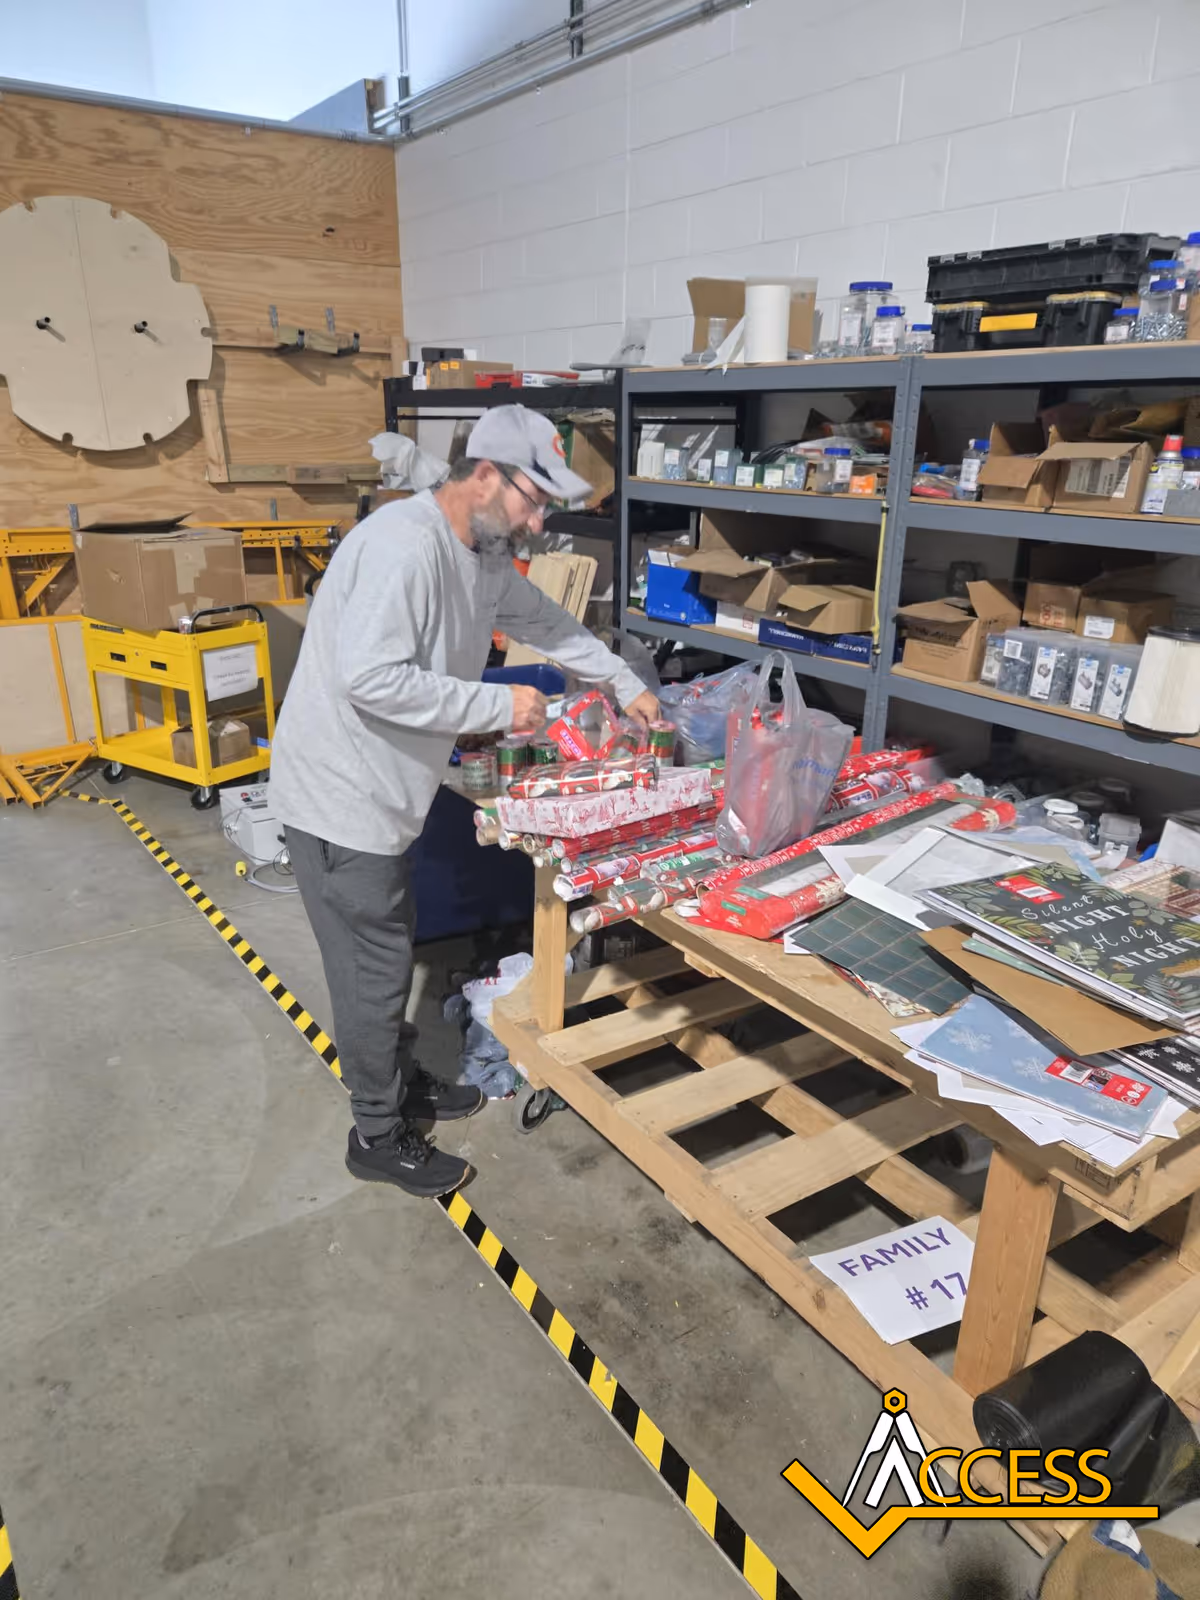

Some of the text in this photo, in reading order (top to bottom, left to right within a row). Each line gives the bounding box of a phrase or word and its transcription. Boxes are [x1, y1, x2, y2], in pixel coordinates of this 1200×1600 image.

[1021, 895, 1094, 920] Silent
[1041, 904, 1130, 935] NIGHT
[1092, 926, 1163, 950] Holy
[1109, 936, 1200, 968] NIGHT
[837, 1227, 952, 1277] FAMILY
